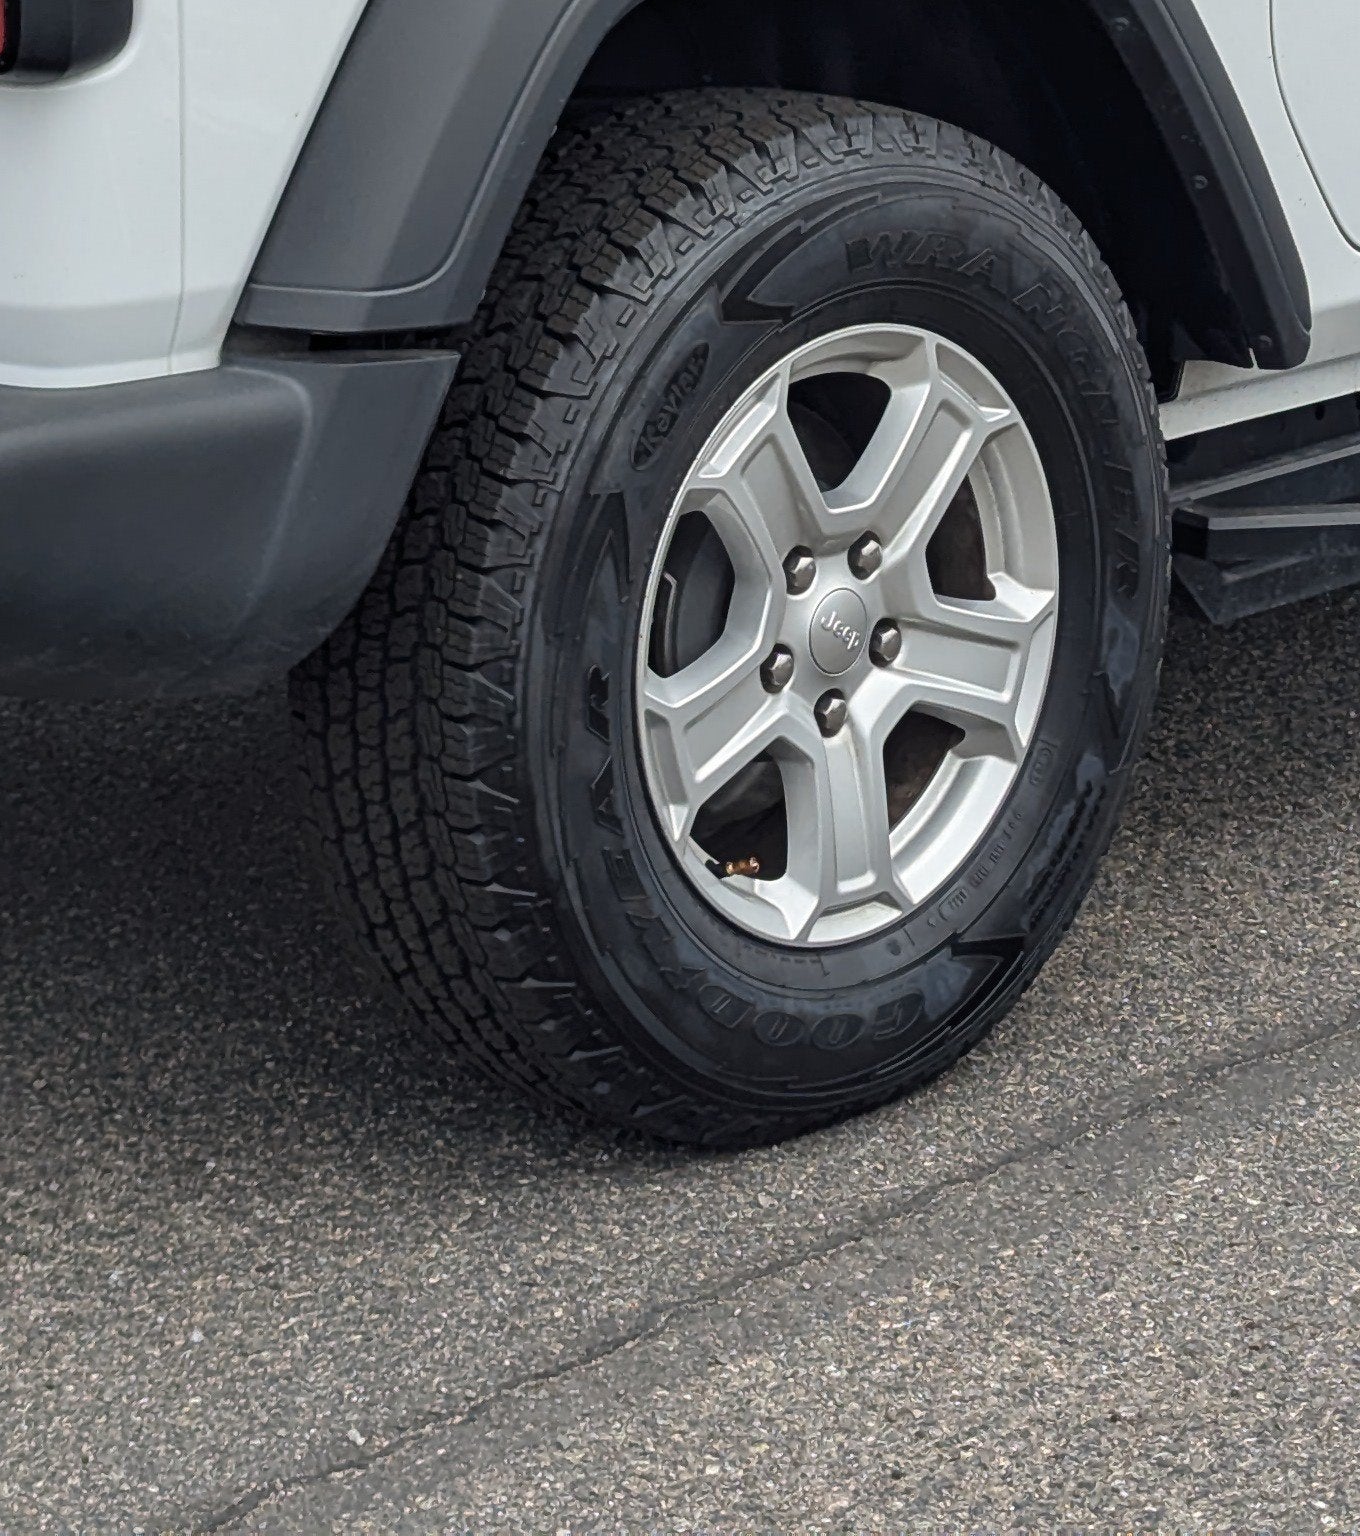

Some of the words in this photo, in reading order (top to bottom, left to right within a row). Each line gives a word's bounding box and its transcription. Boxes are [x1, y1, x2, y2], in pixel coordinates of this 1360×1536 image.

[845, 229, 1142, 601] WRANGLER
[820, 610, 861, 651] Jeep
[585, 663, 926, 1051] GOODYEAR
